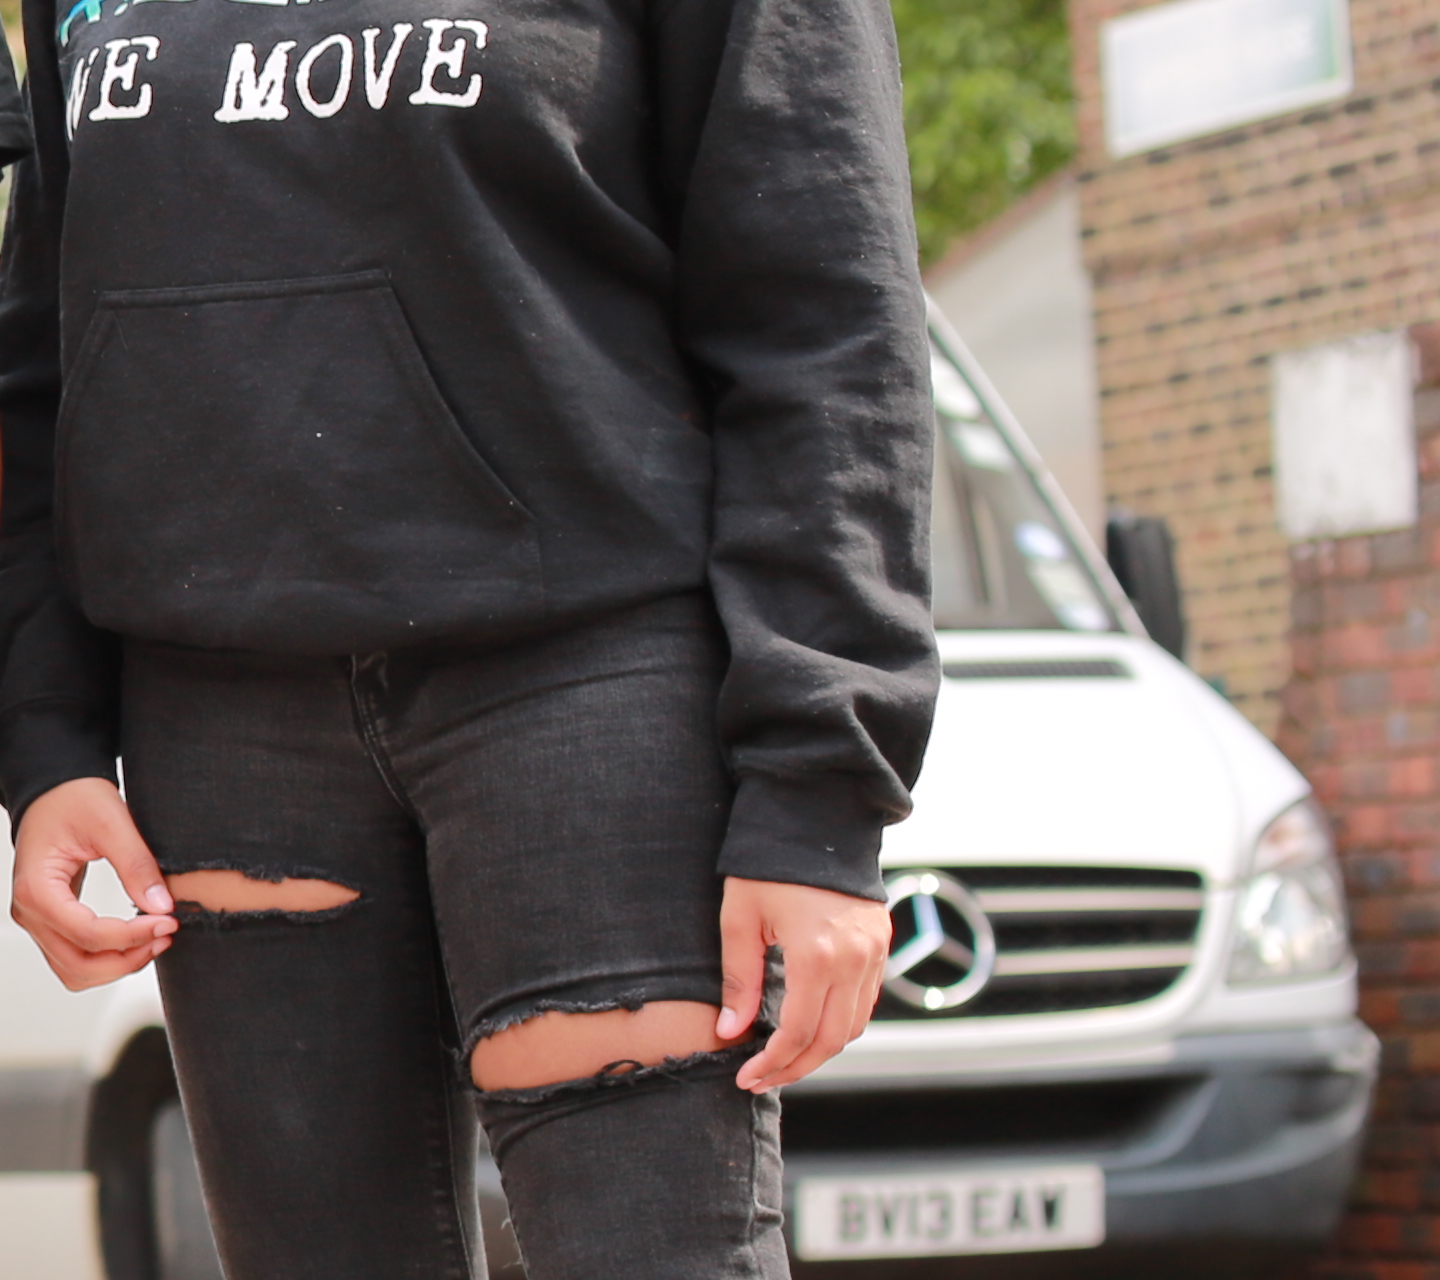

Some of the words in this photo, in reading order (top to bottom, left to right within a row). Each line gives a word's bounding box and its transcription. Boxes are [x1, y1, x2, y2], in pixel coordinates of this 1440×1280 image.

[213, 18, 488, 123] MOVE
[837, 1187, 954, 1244] BV13
[970, 1182, 1068, 1239] EAW
